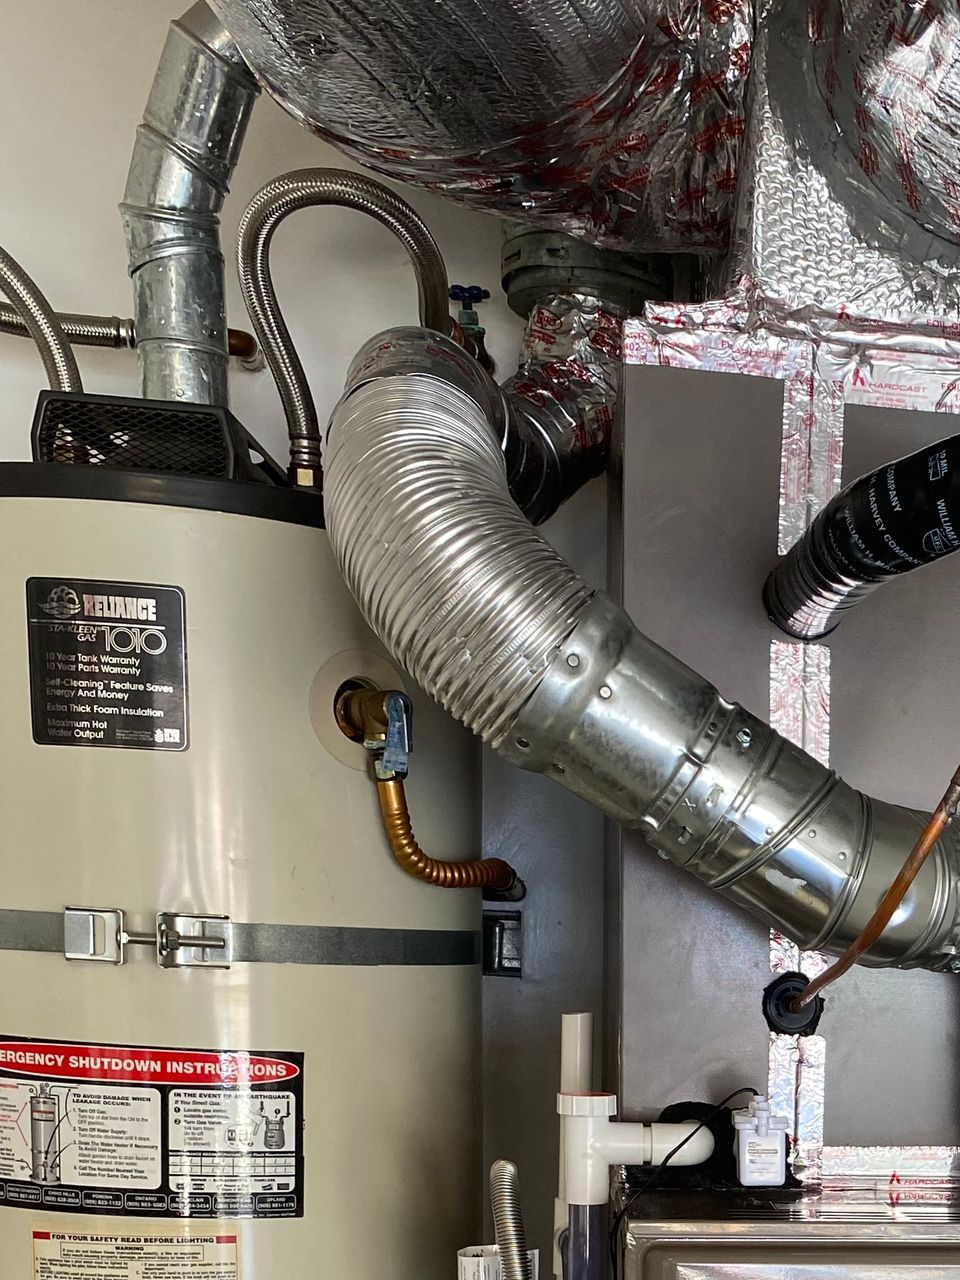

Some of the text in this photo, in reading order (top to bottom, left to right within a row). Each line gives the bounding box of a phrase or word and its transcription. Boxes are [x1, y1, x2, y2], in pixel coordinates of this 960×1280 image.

[869, 382, 928, 393] HARDCAST
[940, 460, 949, 477] MIL
[869, 487, 887, 532] HARVEY
[937, 499, 957, 543] WILLIAM
[843, 506, 866, 551] WILLIAM
[83, 594, 157, 621] RELIANCE
[77, 633, 97, 642] GAS
[102, 626, 168, 655] 1010
[56, 652, 76, 662] Year
[78, 653, 98, 663] Tank
[100, 655, 140, 666] Warranty
[56, 663, 76, 671] Year
[78, 663, 99, 673] Parts
[100, 665, 141, 677] Warranty
[110, 681, 144, 691] Feature
[146, 684, 174, 693] Saves
[46, 688, 129, 701] Energy And Money
[46, 703, 164, 718] Extra Thick Foam Insulation
[47, 718, 108, 729] Maximum Hot
[48, 729, 73, 738] Water
[73, 729, 104, 739] Output
[69, 1055, 161, 1073] SHUTDOWN
